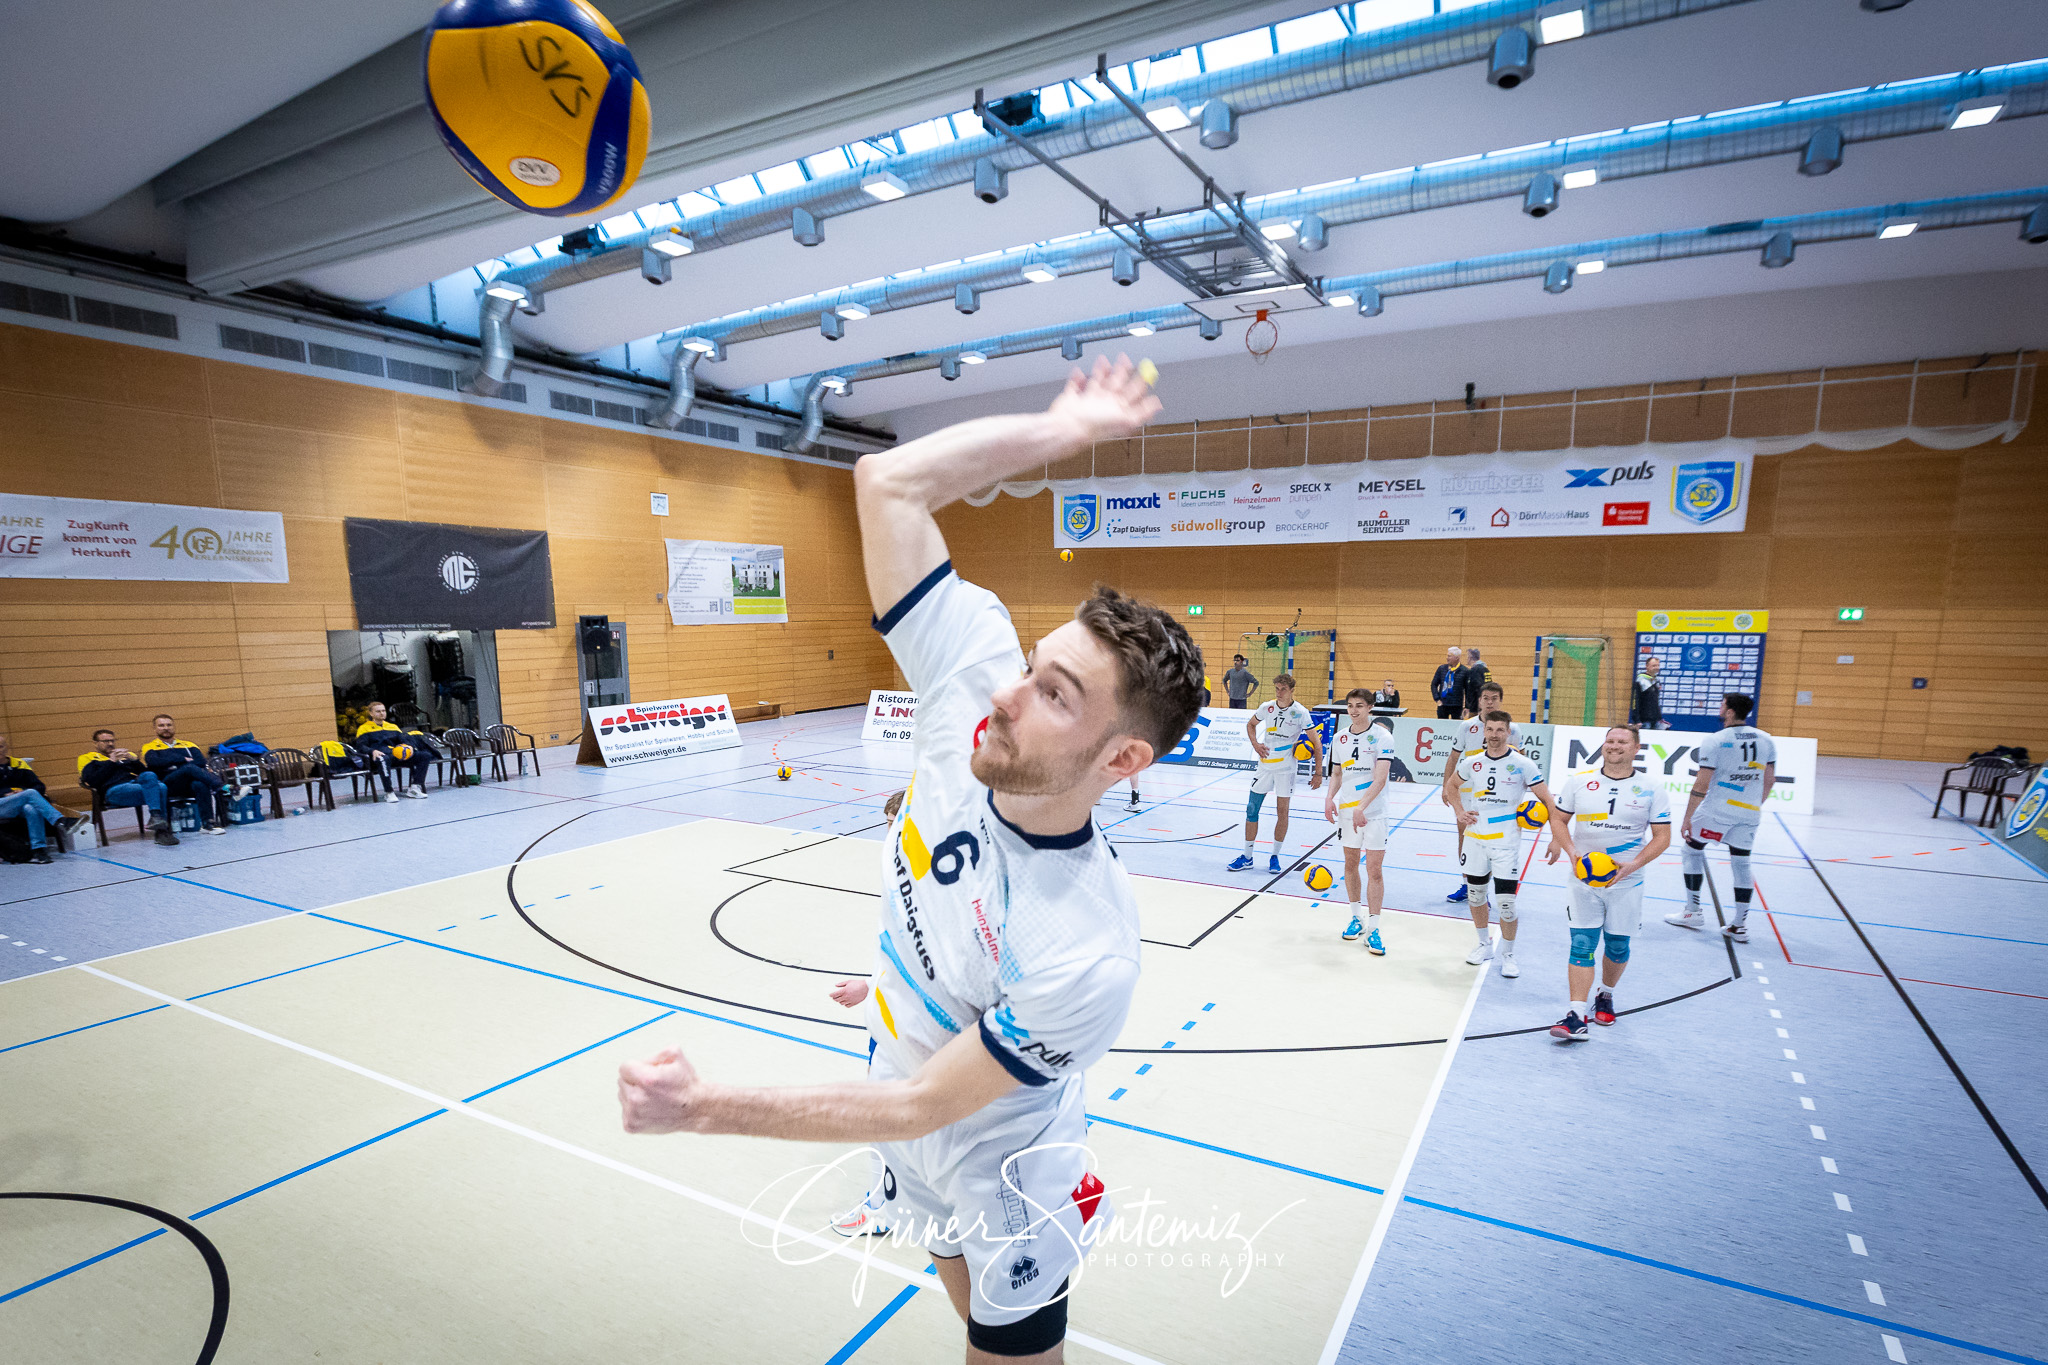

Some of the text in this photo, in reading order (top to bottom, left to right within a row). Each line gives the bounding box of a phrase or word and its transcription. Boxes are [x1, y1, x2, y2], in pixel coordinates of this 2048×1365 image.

[1610, 460, 1656, 486] puls
[1289, 483, 1321, 493] SPECK
[1358, 479, 1426, 493] MEYSEL
[1106, 492, 1161, 510] maxit
[1181, 489, 1226, 500] FUCHS
[1233, 496, 1281, 504] Heinzelmann
[1289, 494, 1322, 503] pumpen
[66, 519, 131, 532] ZugKunft
[1112, 525, 1161, 534] Zapf Daigfuss
[1363, 526, 1404, 534] SERVICES
[62, 532, 137, 545] kommt von
[225, 530, 273, 545] JAHRE
[71, 547, 132, 558] Herkunft
[635, 703, 680, 714] Spielwaren
[600, 703, 727, 736] schweiger
[1273, 716, 1286, 728] 17
[883, 729, 897, 739] fon
[609, 745, 687, 764] www.schweiger.de
[1351, 746, 1360, 761] 4
[1740, 740, 1758, 763] 11
[1486, 776, 1496, 791] 9
[1607, 797, 1617, 816] 1
[930, 830, 980, 886] 6
[1459, 852, 1467, 866] 9
[1011, 1267, 1040, 1291] errea
